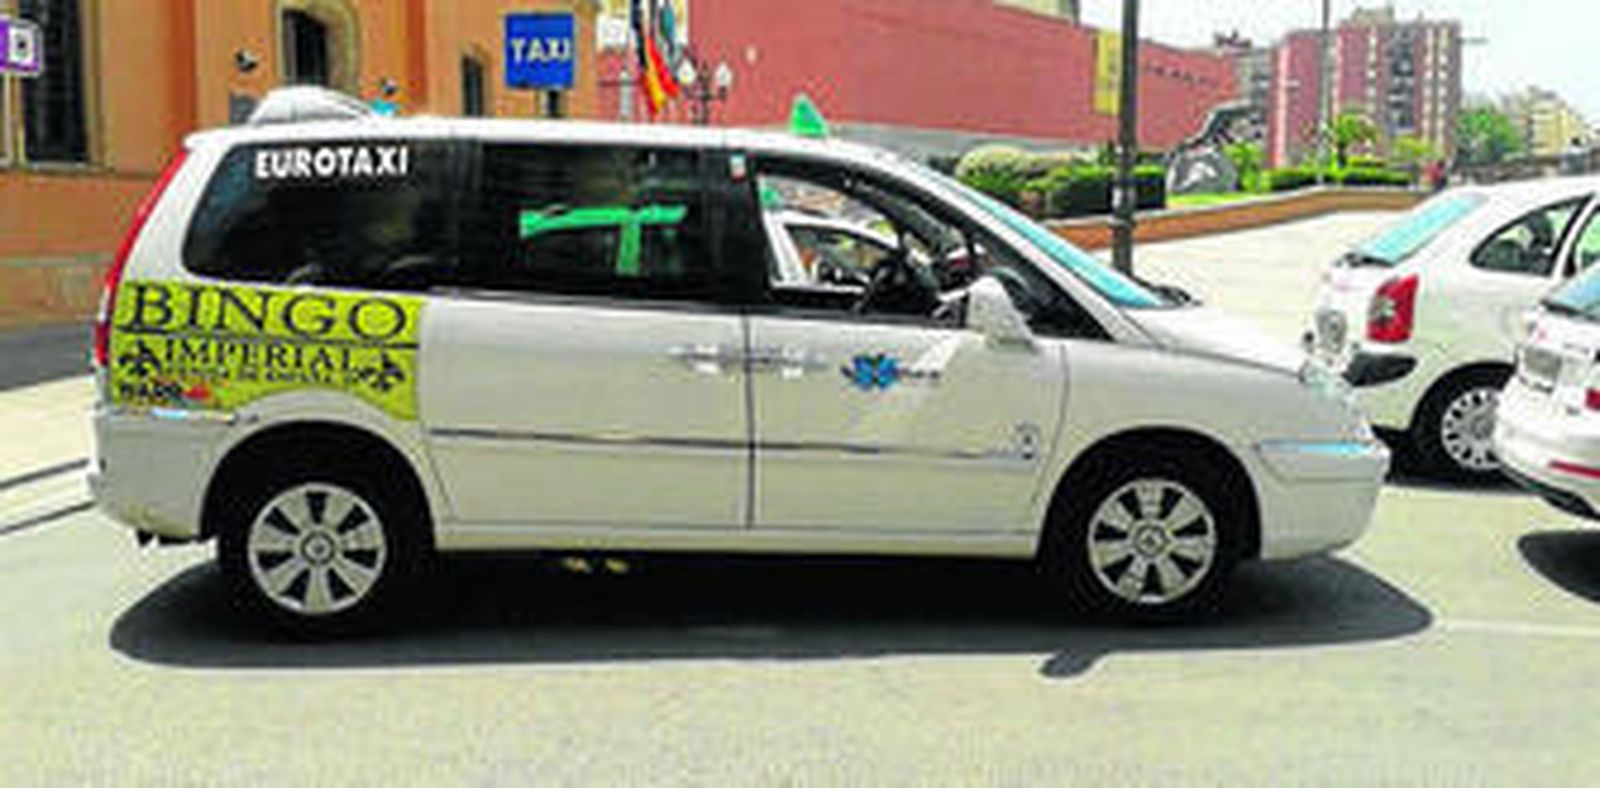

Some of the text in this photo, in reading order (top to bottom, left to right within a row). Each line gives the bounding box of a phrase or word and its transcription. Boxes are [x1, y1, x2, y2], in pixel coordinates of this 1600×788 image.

[510, 38, 571, 63] TAXI
[255, 146, 408, 179] EUROTAXI
[127, 284, 407, 340] BINGO
[164, 338, 356, 372] IMPERIAL
